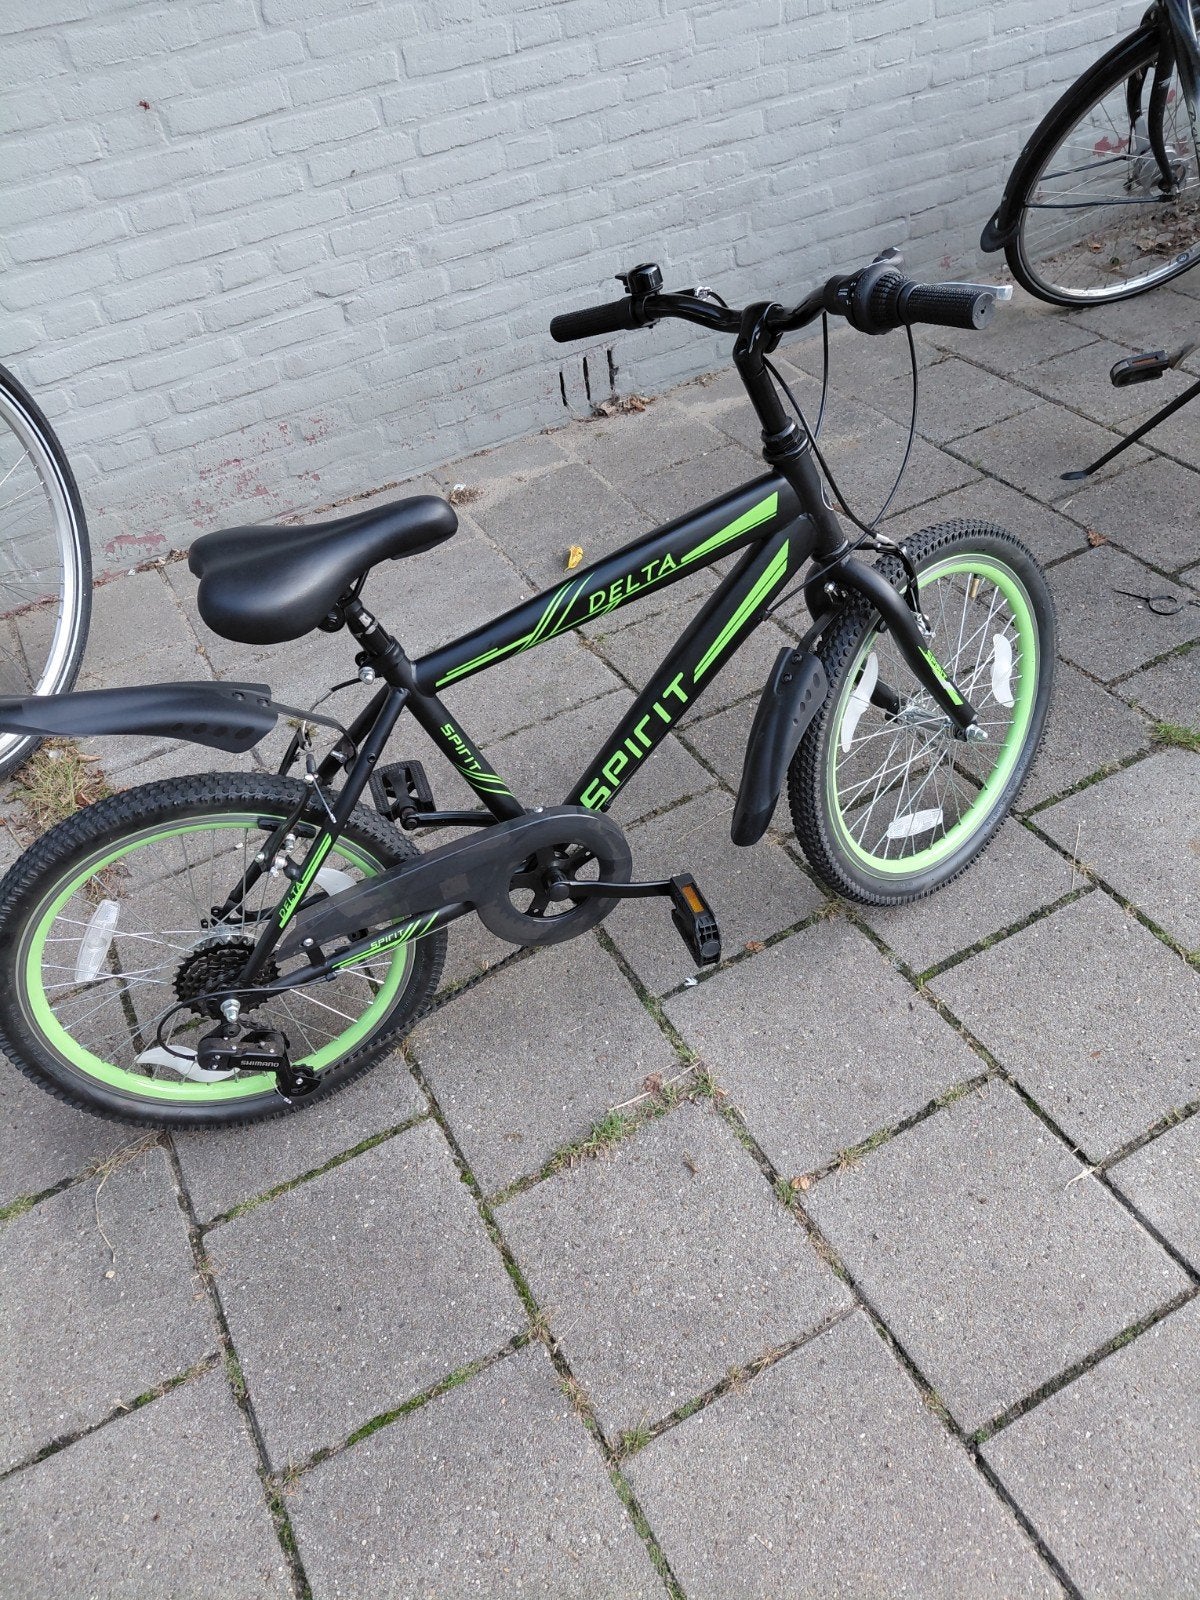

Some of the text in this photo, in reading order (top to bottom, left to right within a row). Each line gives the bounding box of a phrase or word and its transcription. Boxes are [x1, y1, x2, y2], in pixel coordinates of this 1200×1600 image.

[588, 553, 677, 614] DELTA
[440, 723, 481, 770] SPIRIT
[579, 672, 688, 811] SPIRIT
[279, 881, 304, 919] DELTA
[370, 929, 404, 948] SPIRIT
[240, 1060, 279, 1068] SHIMANO
